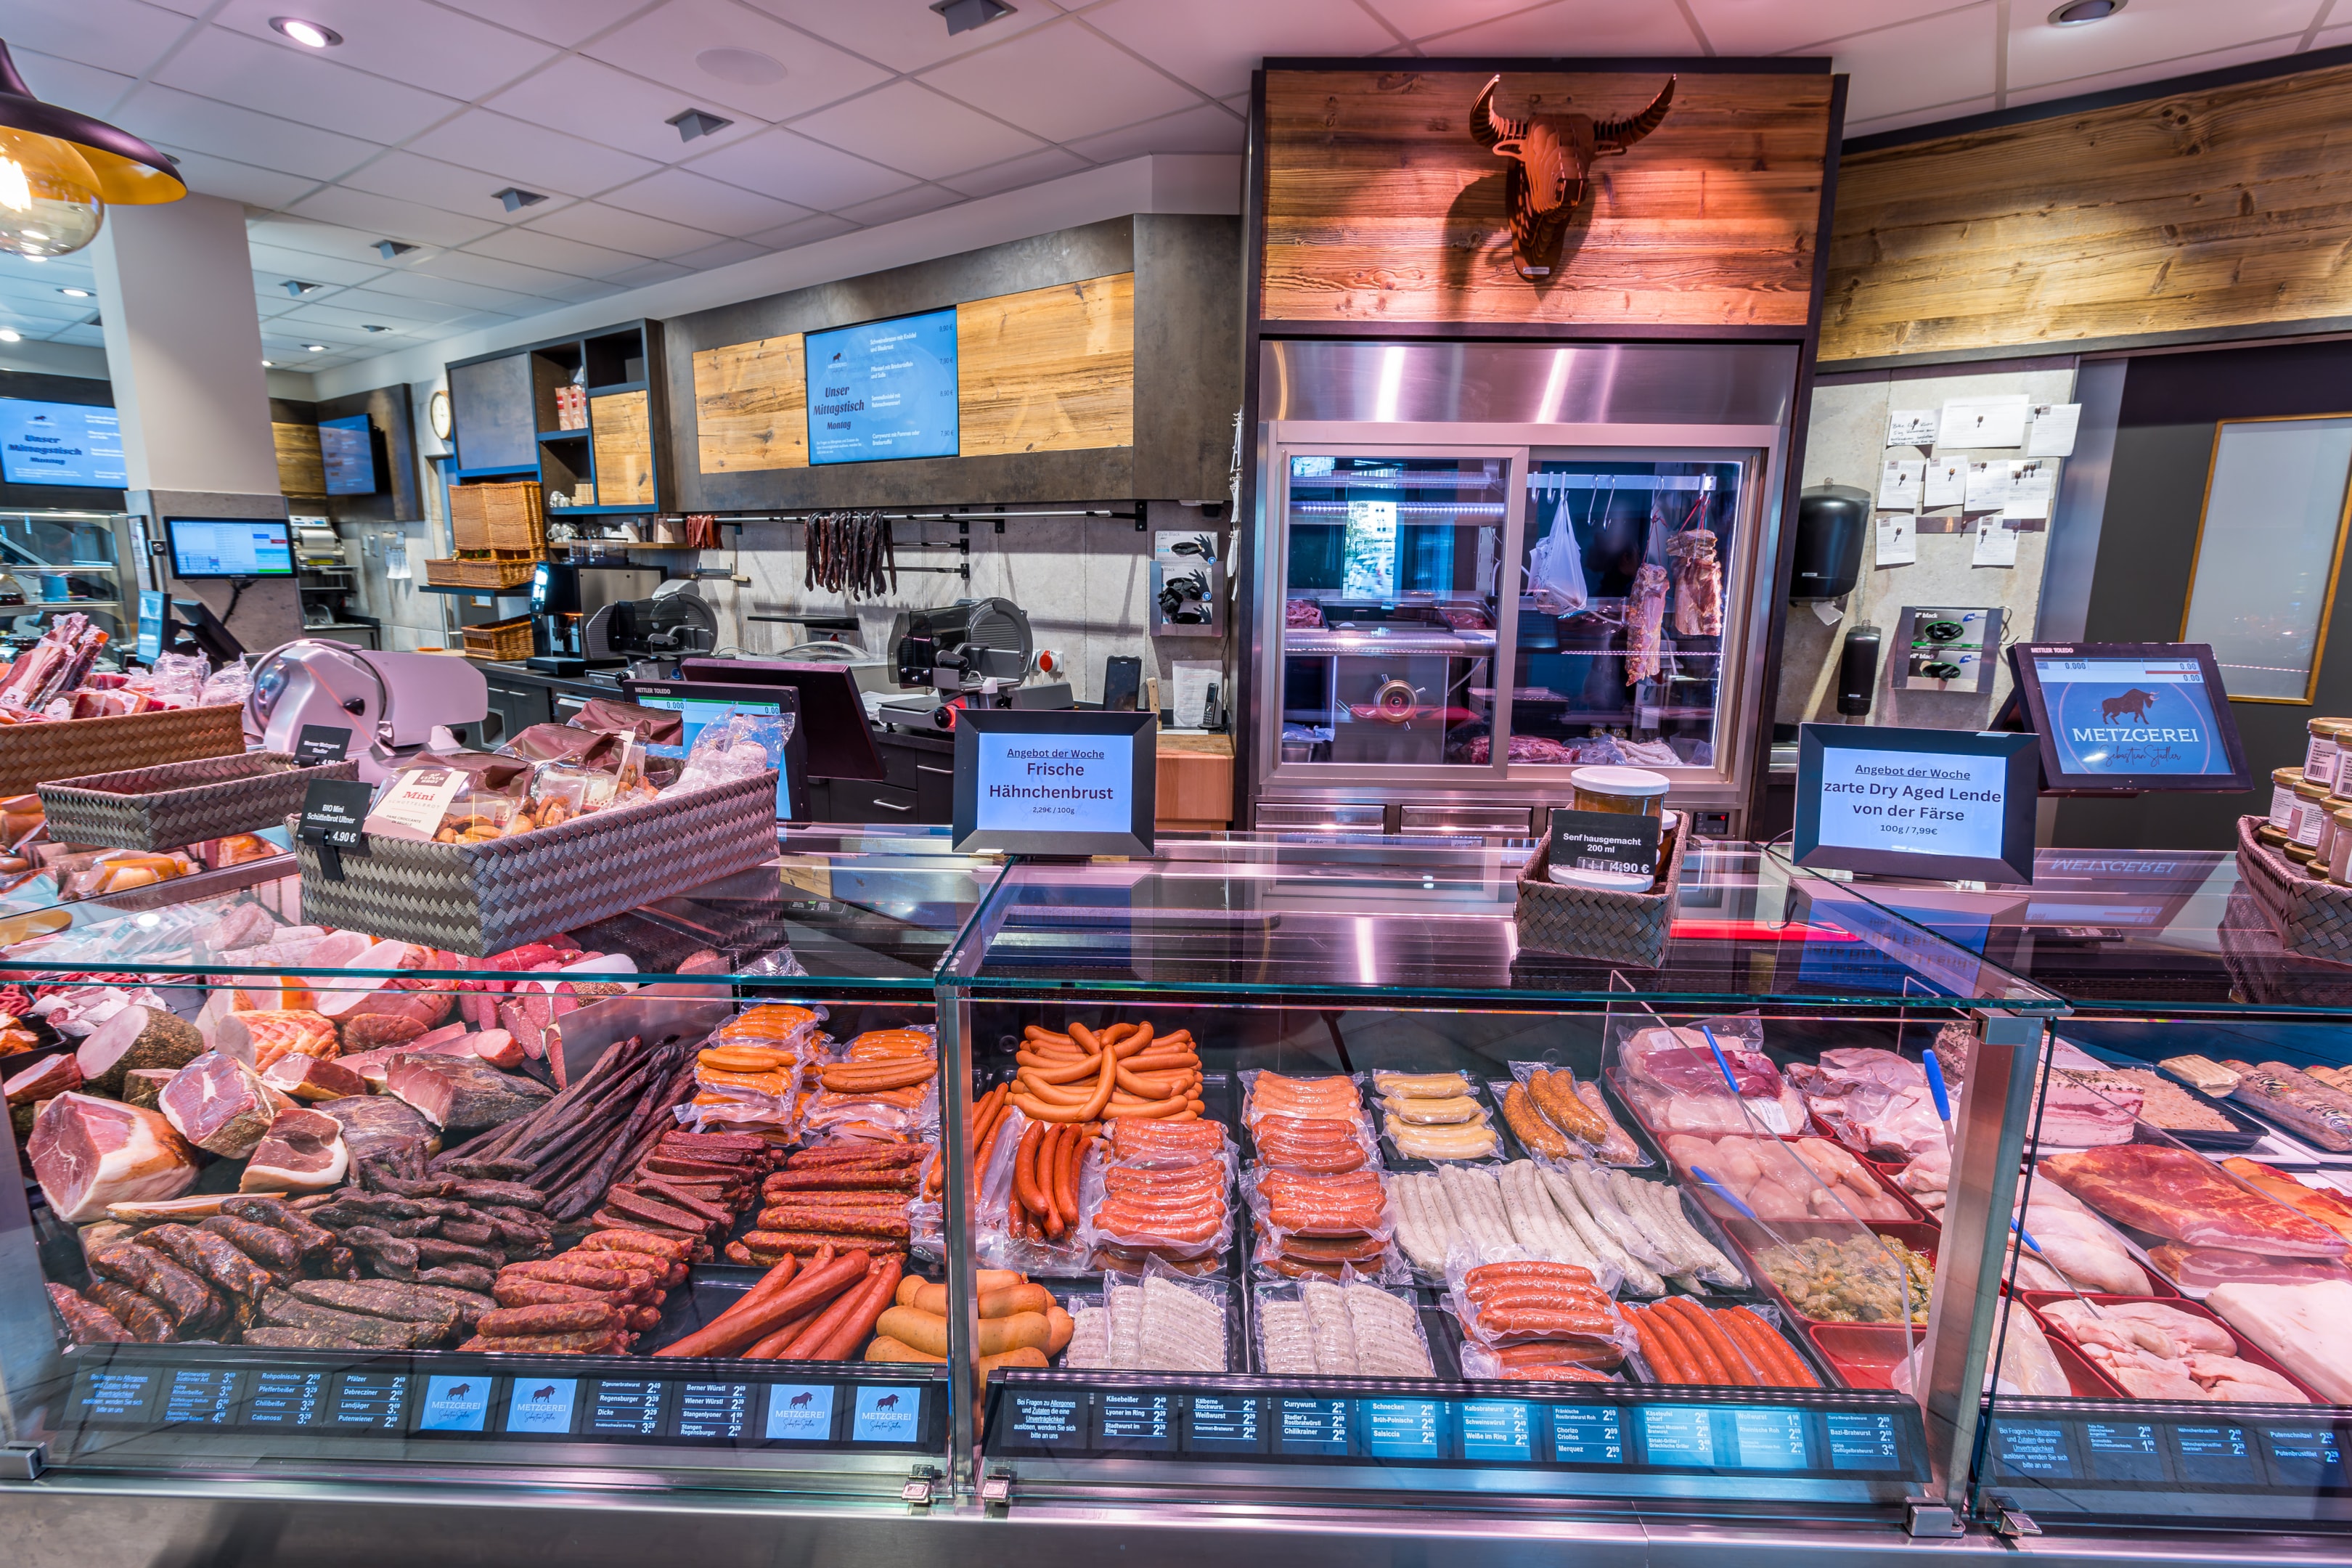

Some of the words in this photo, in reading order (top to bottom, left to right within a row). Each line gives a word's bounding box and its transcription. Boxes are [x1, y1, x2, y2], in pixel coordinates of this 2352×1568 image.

[825, 386, 849, 398] Unser
[813, 400, 865, 415] Mittagstisch
[827, 421, 851, 430] Montag
[25, 435, 60, 444] Unser
[8, 444, 82, 455] Mittagstisch
[2072, 728, 2200, 742] METZGEREI
[1007, 748, 1049, 759] Angebot
[1071, 750, 1104, 759] Woche
[1027, 763, 1084, 776] Frische
[1855, 764, 1904, 776] Angebot
[1908, 767, 1927, 777] der
[1930, 769, 1970, 780] Woche
[403, 792, 435, 801] Mini
[989, 785, 1113, 799] Hähnchenbrust
[1824, 783, 1865, 793] zarte
[1870, 783, 1898, 799] Dry
[1903, 785, 1944, 800] Aged
[1950, 788, 2001, 802] Lende
[307, 812, 338, 822] Schüttelbrot
[339, 814, 355, 824] Ultner
[1853, 804, 1882, 815] von
[1887, 804, 1915, 817] der
[1920, 807, 1964, 821] Färse
[1880, 825, 1903, 834] 100g
[1911, 827, 1937, 836] 7,99€
[332, 831, 349, 842] 4.90
[351, 833, 356, 842] €
[1584, 835, 1641, 846] hausgemacht
[1612, 862, 1638, 873] 4.90
[1641, 865, 1649, 873] €
